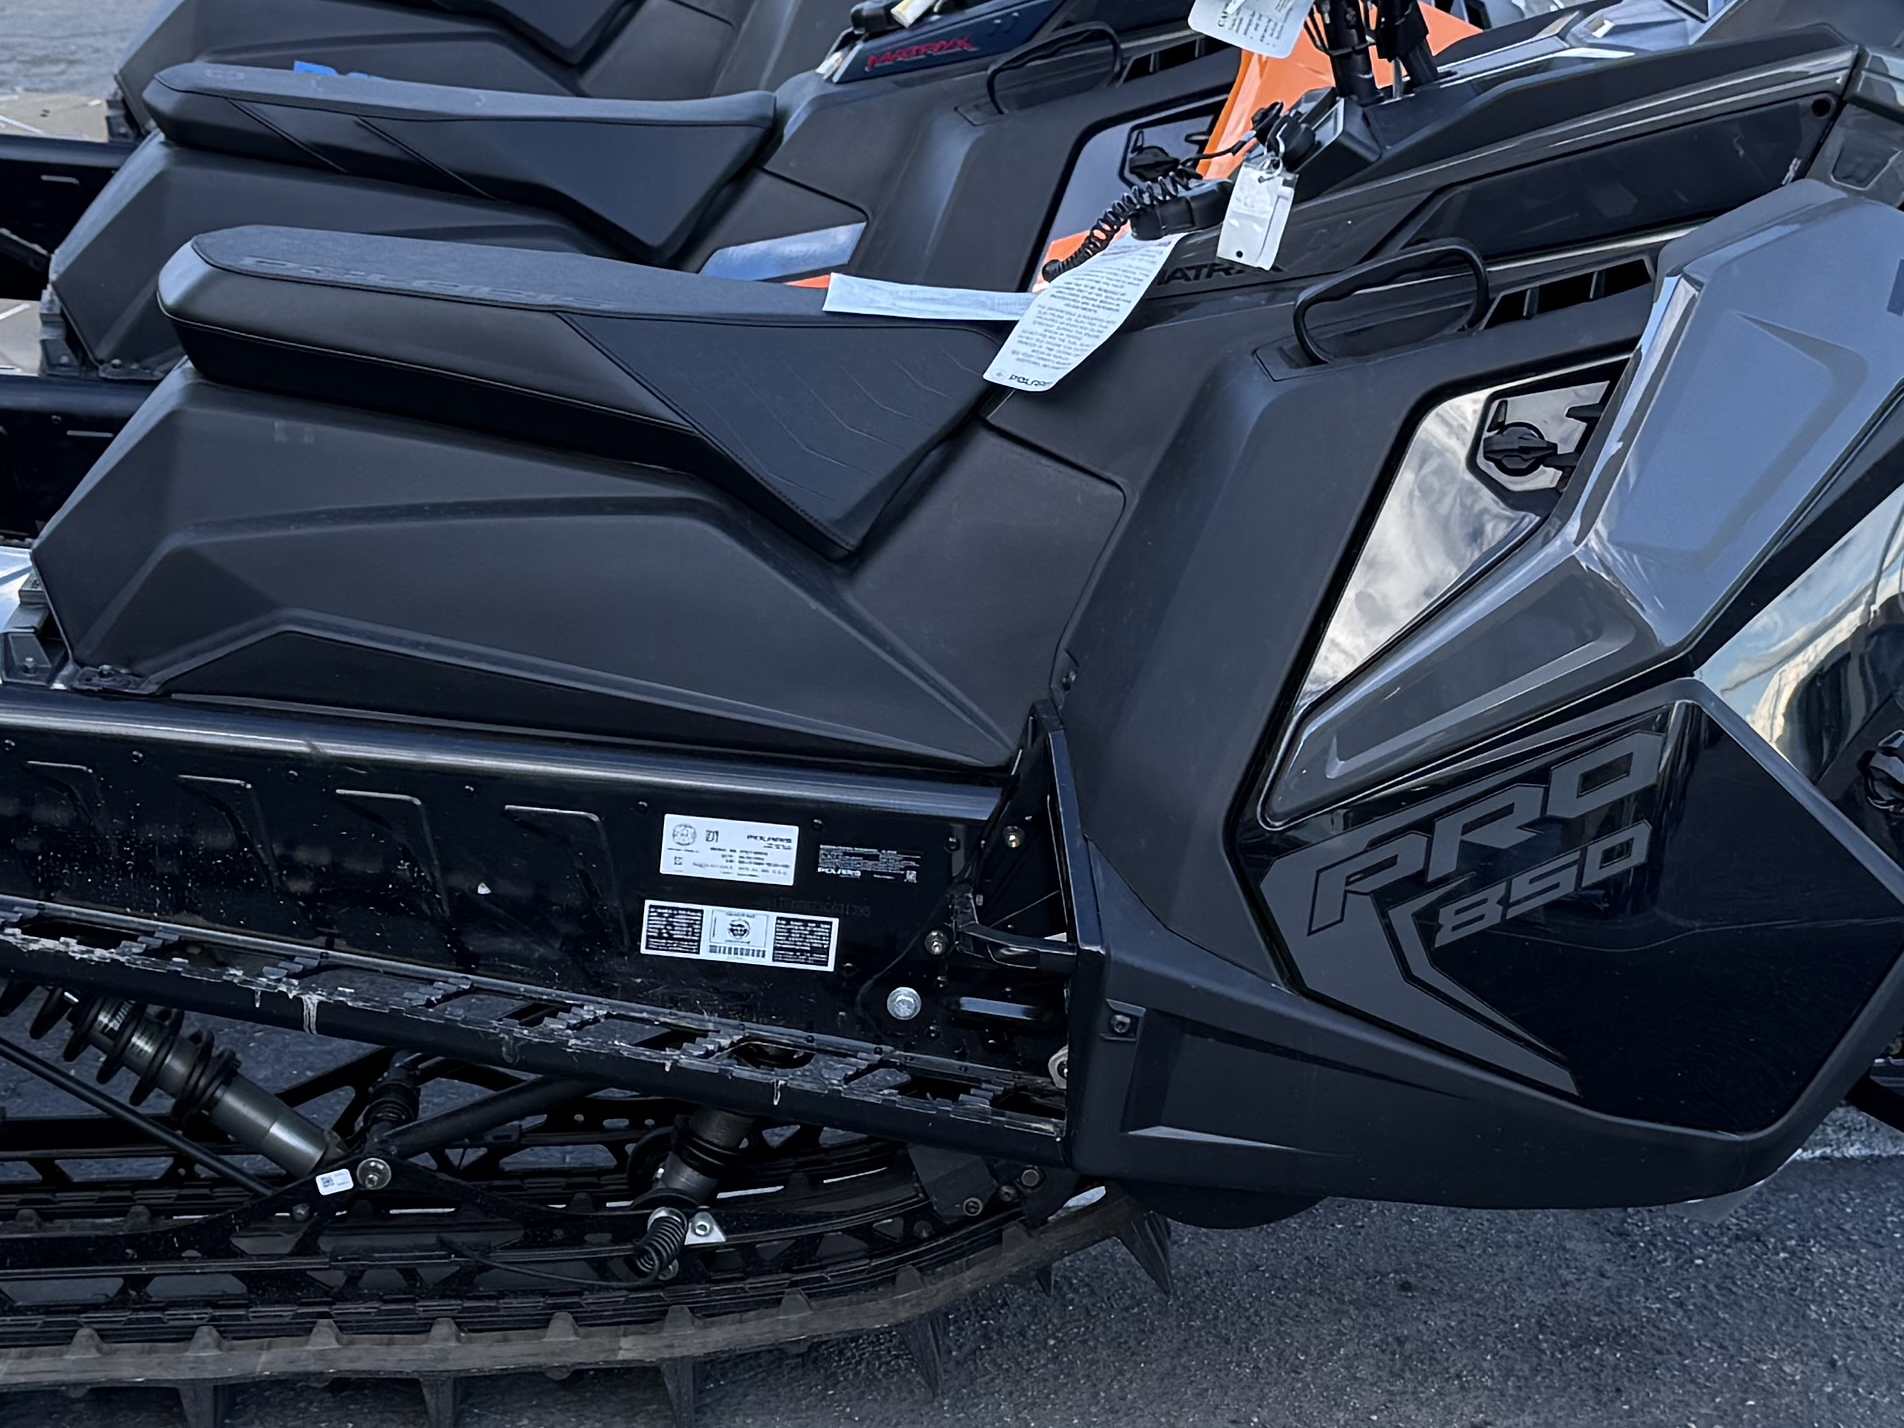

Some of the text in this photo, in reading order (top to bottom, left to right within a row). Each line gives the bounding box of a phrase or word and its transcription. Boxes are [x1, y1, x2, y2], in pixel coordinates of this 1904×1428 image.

[865, 37, 980, 72] MATRYX
[1307, 729, 1664, 937] PRO
[1434, 819, 1653, 949] 850
